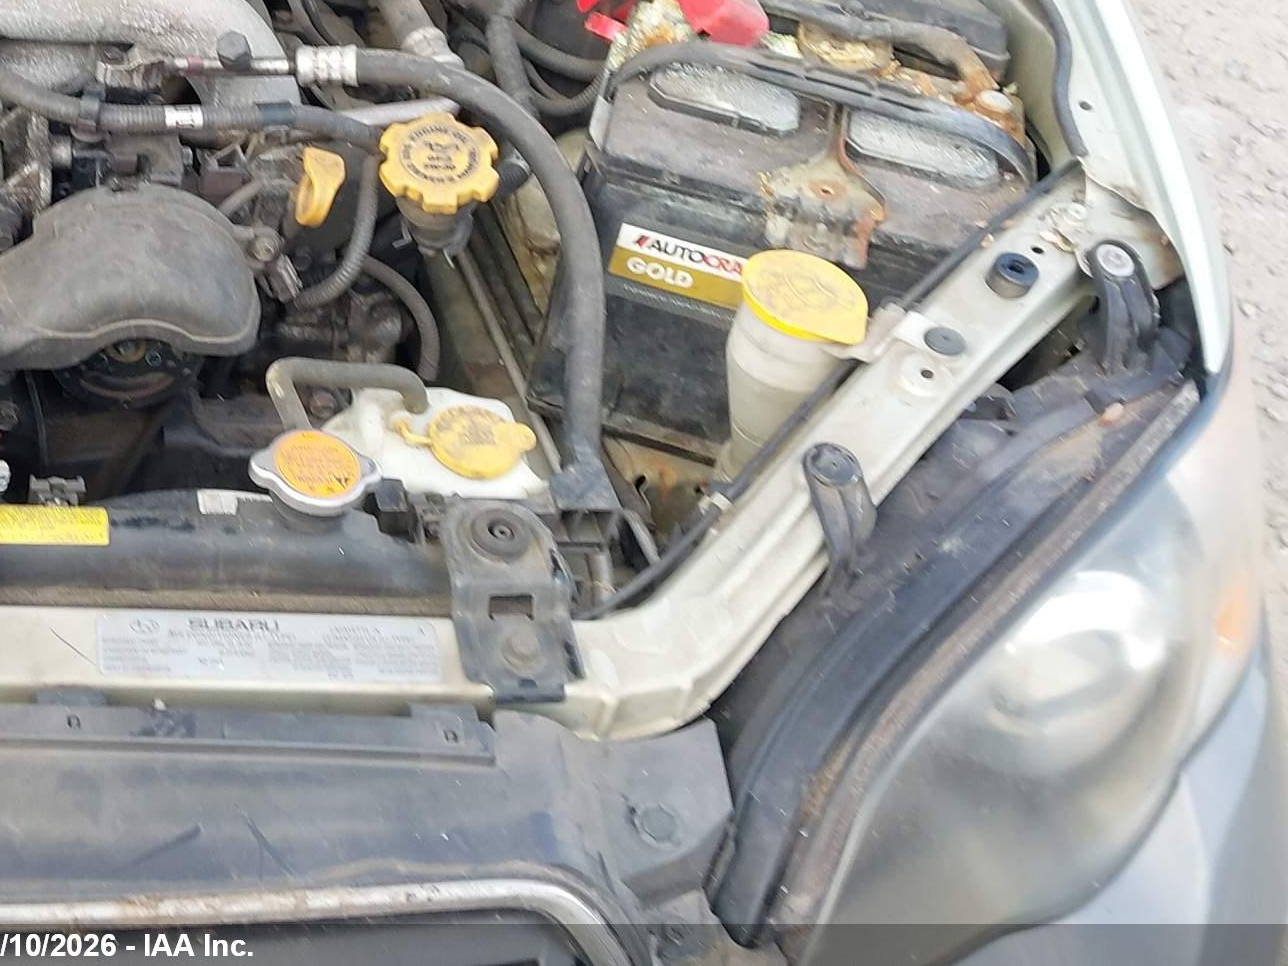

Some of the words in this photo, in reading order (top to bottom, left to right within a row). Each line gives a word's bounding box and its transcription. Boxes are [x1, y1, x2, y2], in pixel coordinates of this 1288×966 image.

[626, 256, 694, 289] GOLD
[650, 239, 744, 275] AUTOCRA
[187, 617, 280, 632] SUBARU
